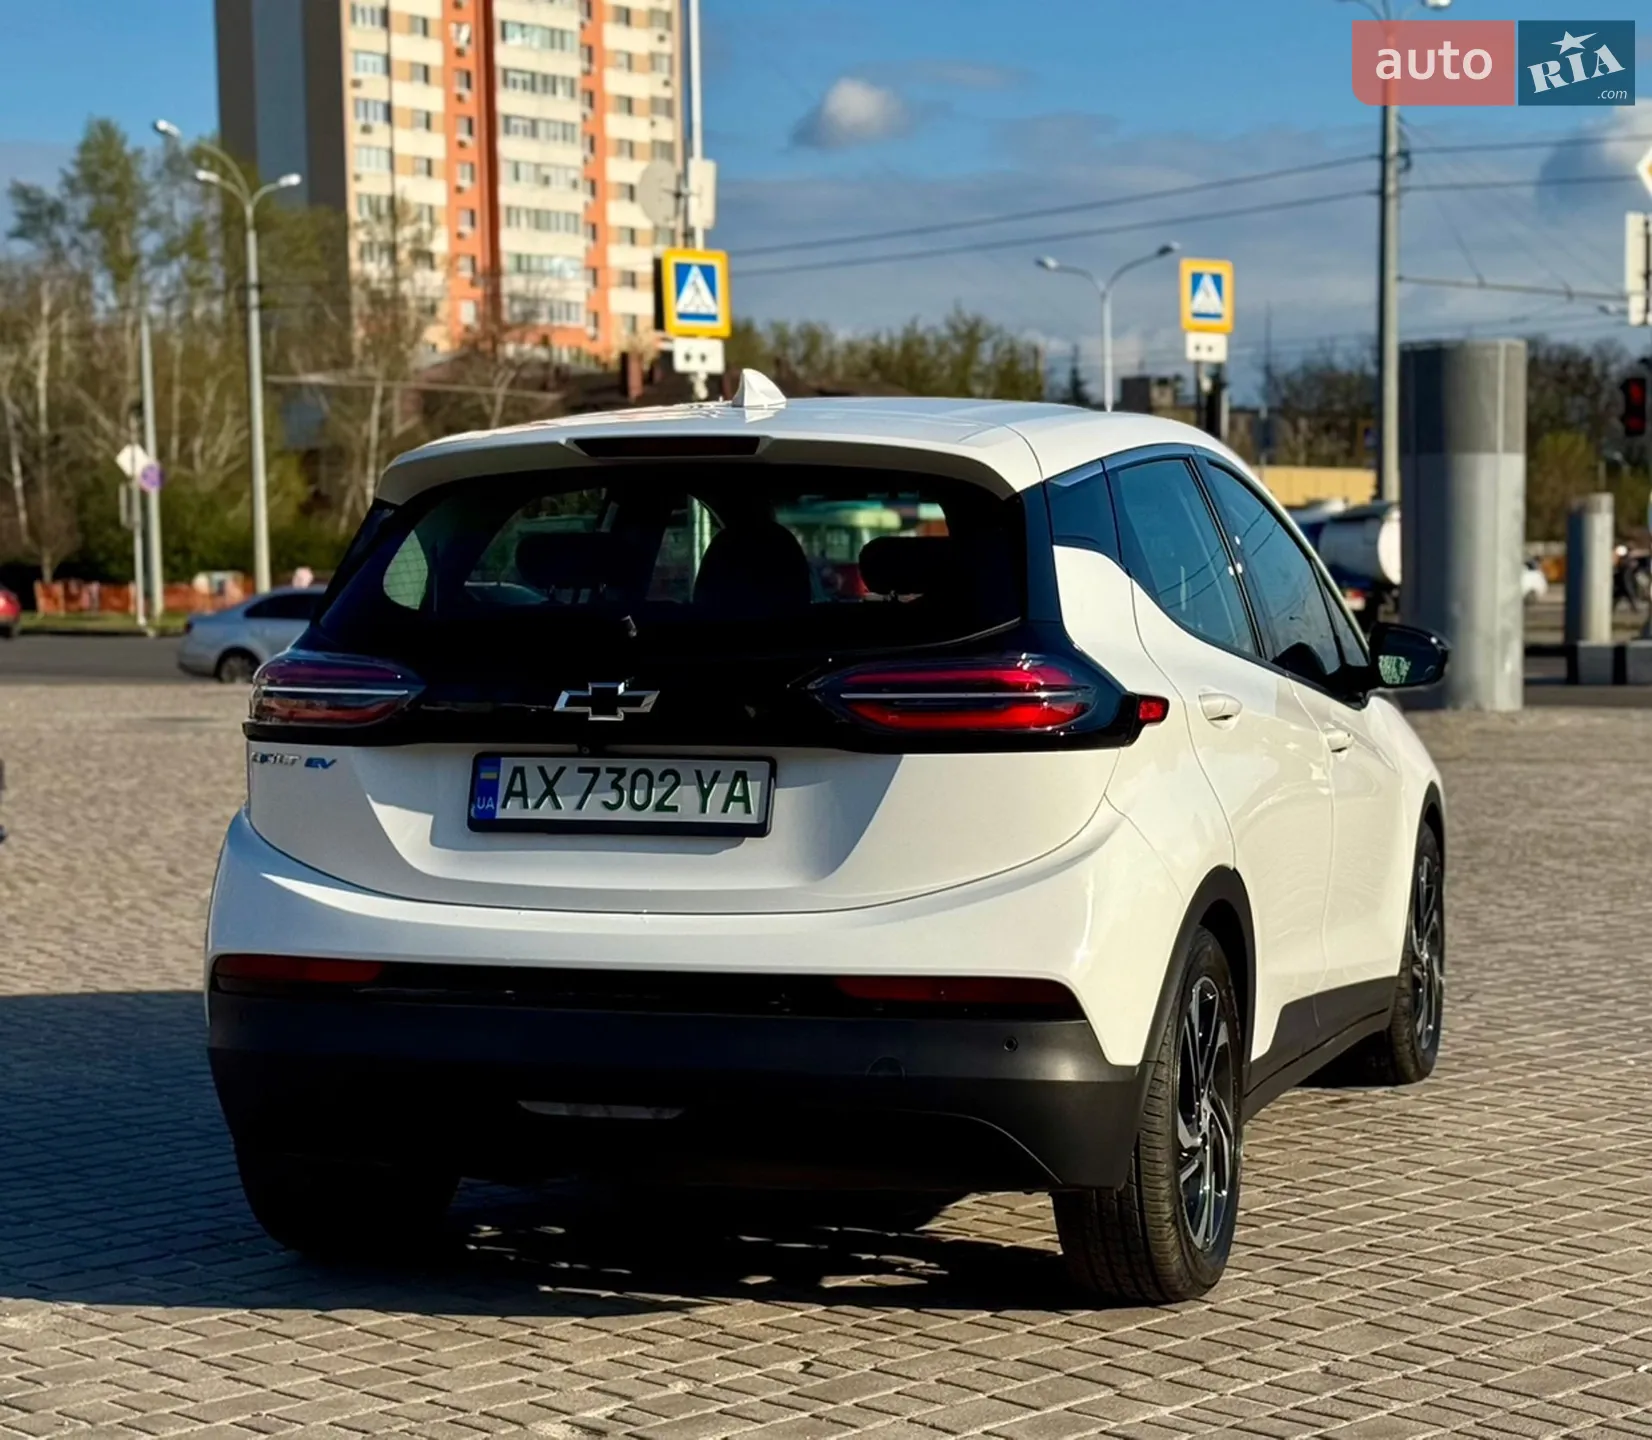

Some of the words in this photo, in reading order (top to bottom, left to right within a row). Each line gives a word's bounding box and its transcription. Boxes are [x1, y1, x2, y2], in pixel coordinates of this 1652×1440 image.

[476, 796, 495, 810] UA
[501, 765, 567, 810] AX
[574, 766, 682, 813] 7302
[694, 769, 753, 815] YA
